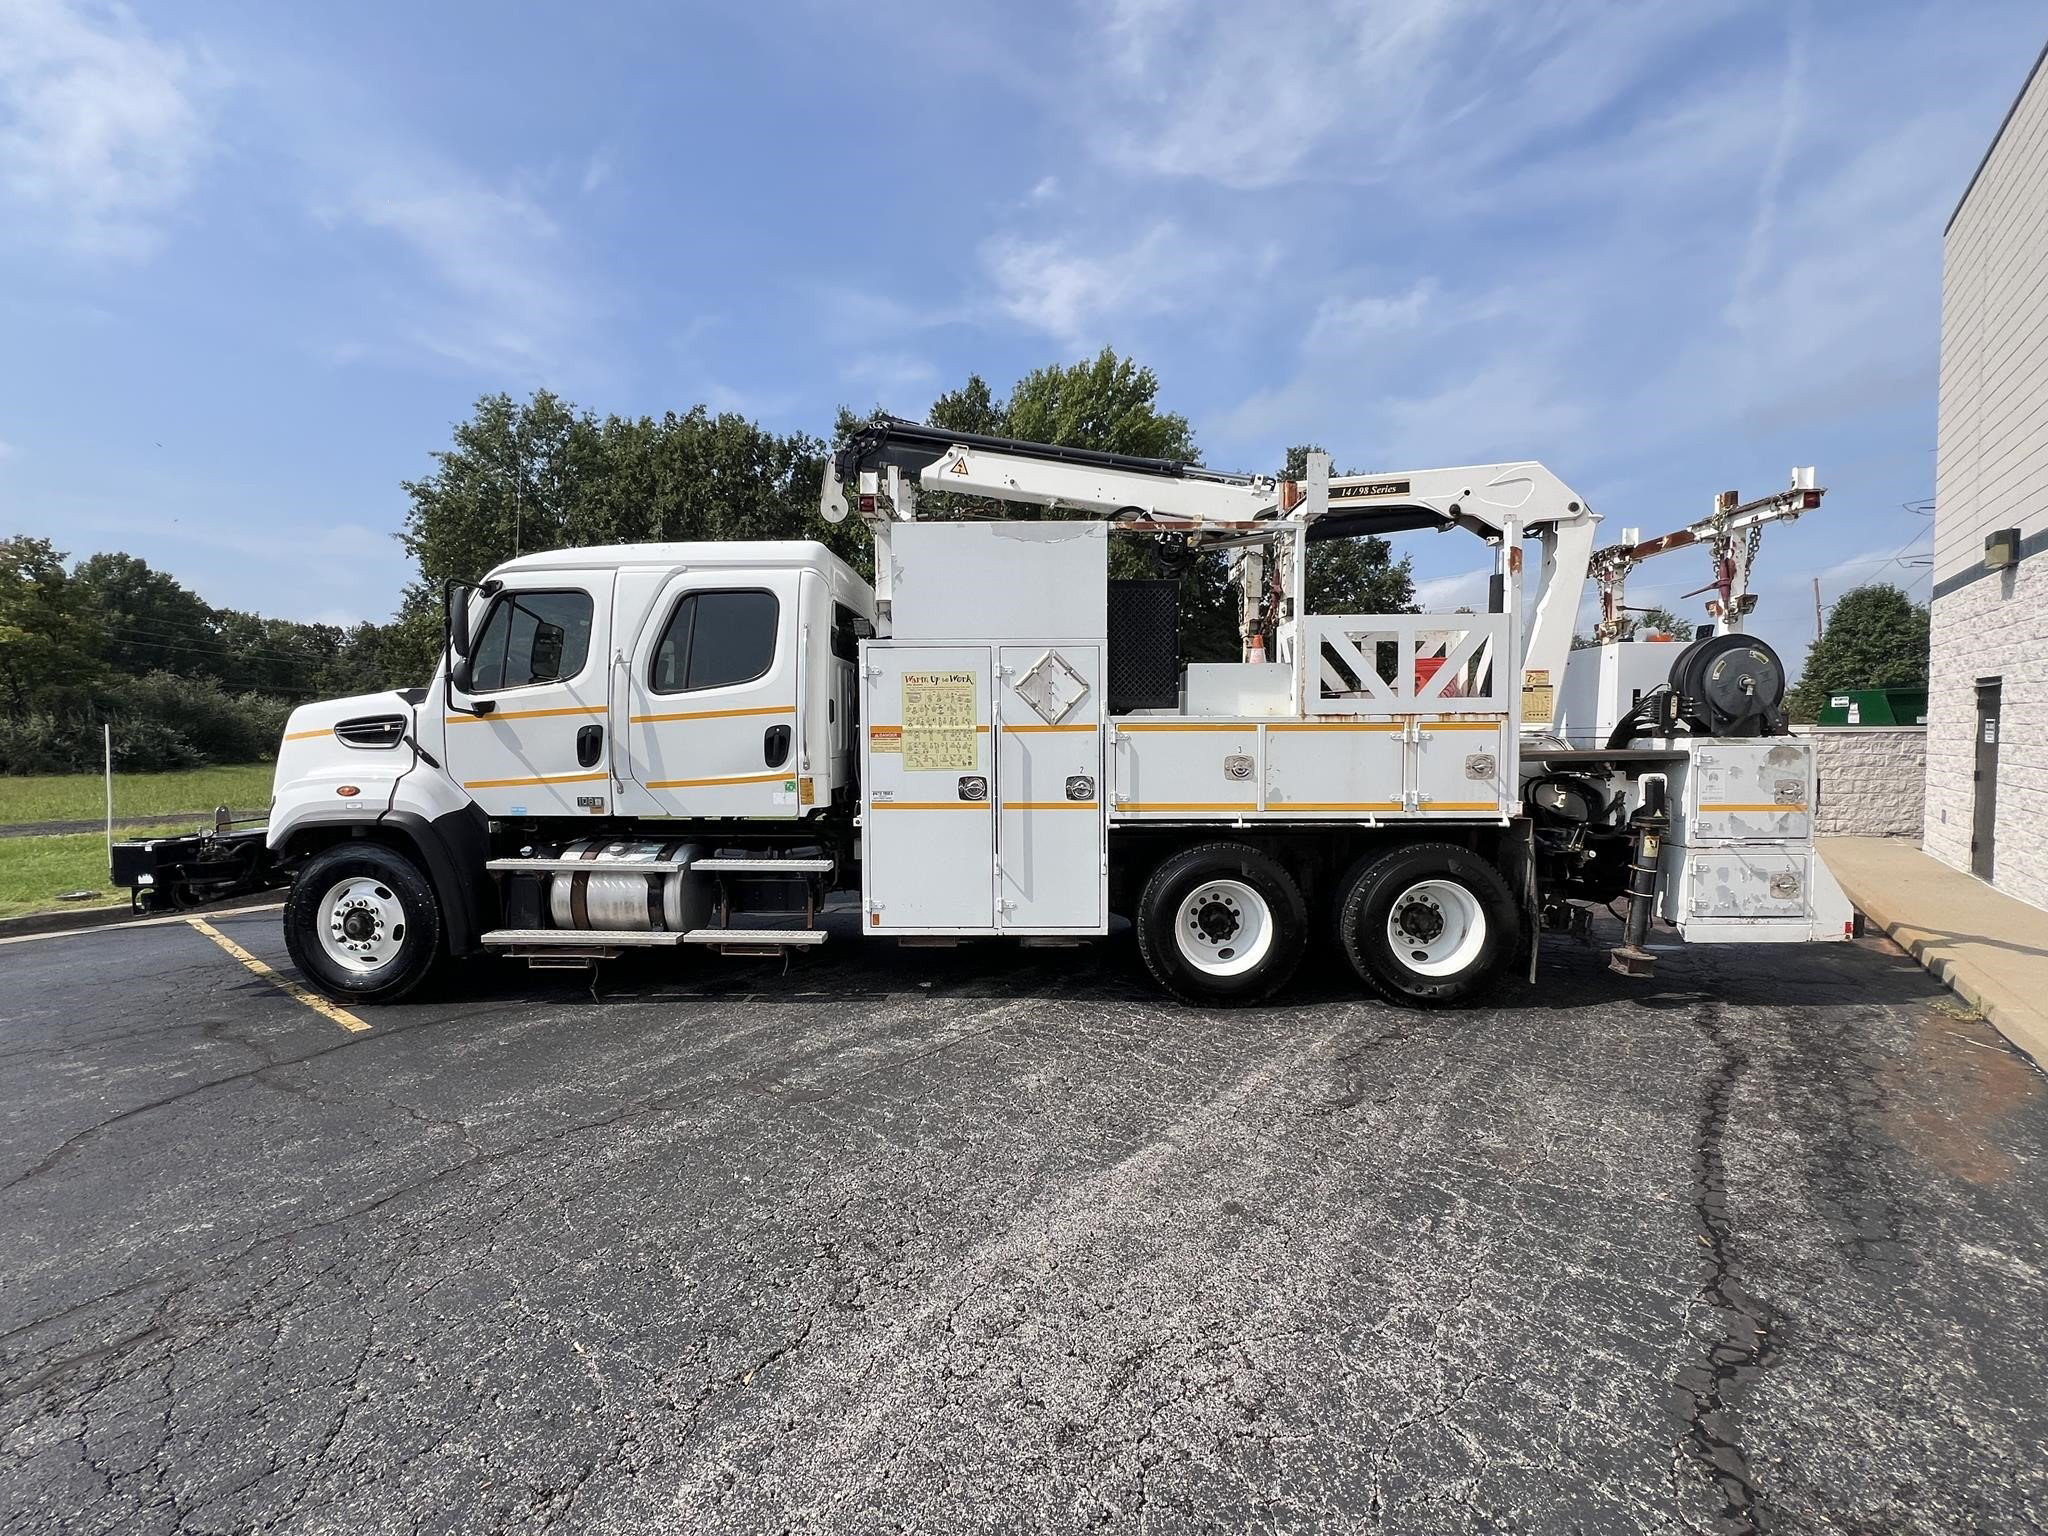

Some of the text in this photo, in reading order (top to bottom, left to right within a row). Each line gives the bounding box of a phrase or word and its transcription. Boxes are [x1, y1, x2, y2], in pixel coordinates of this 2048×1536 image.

[1370, 485, 1397, 494] Series
[930, 675, 939, 685] Up
[949, 674, 975, 685] Work
[1079, 766, 1084, 774] 2
[1785, 864, 1791, 872] 5
